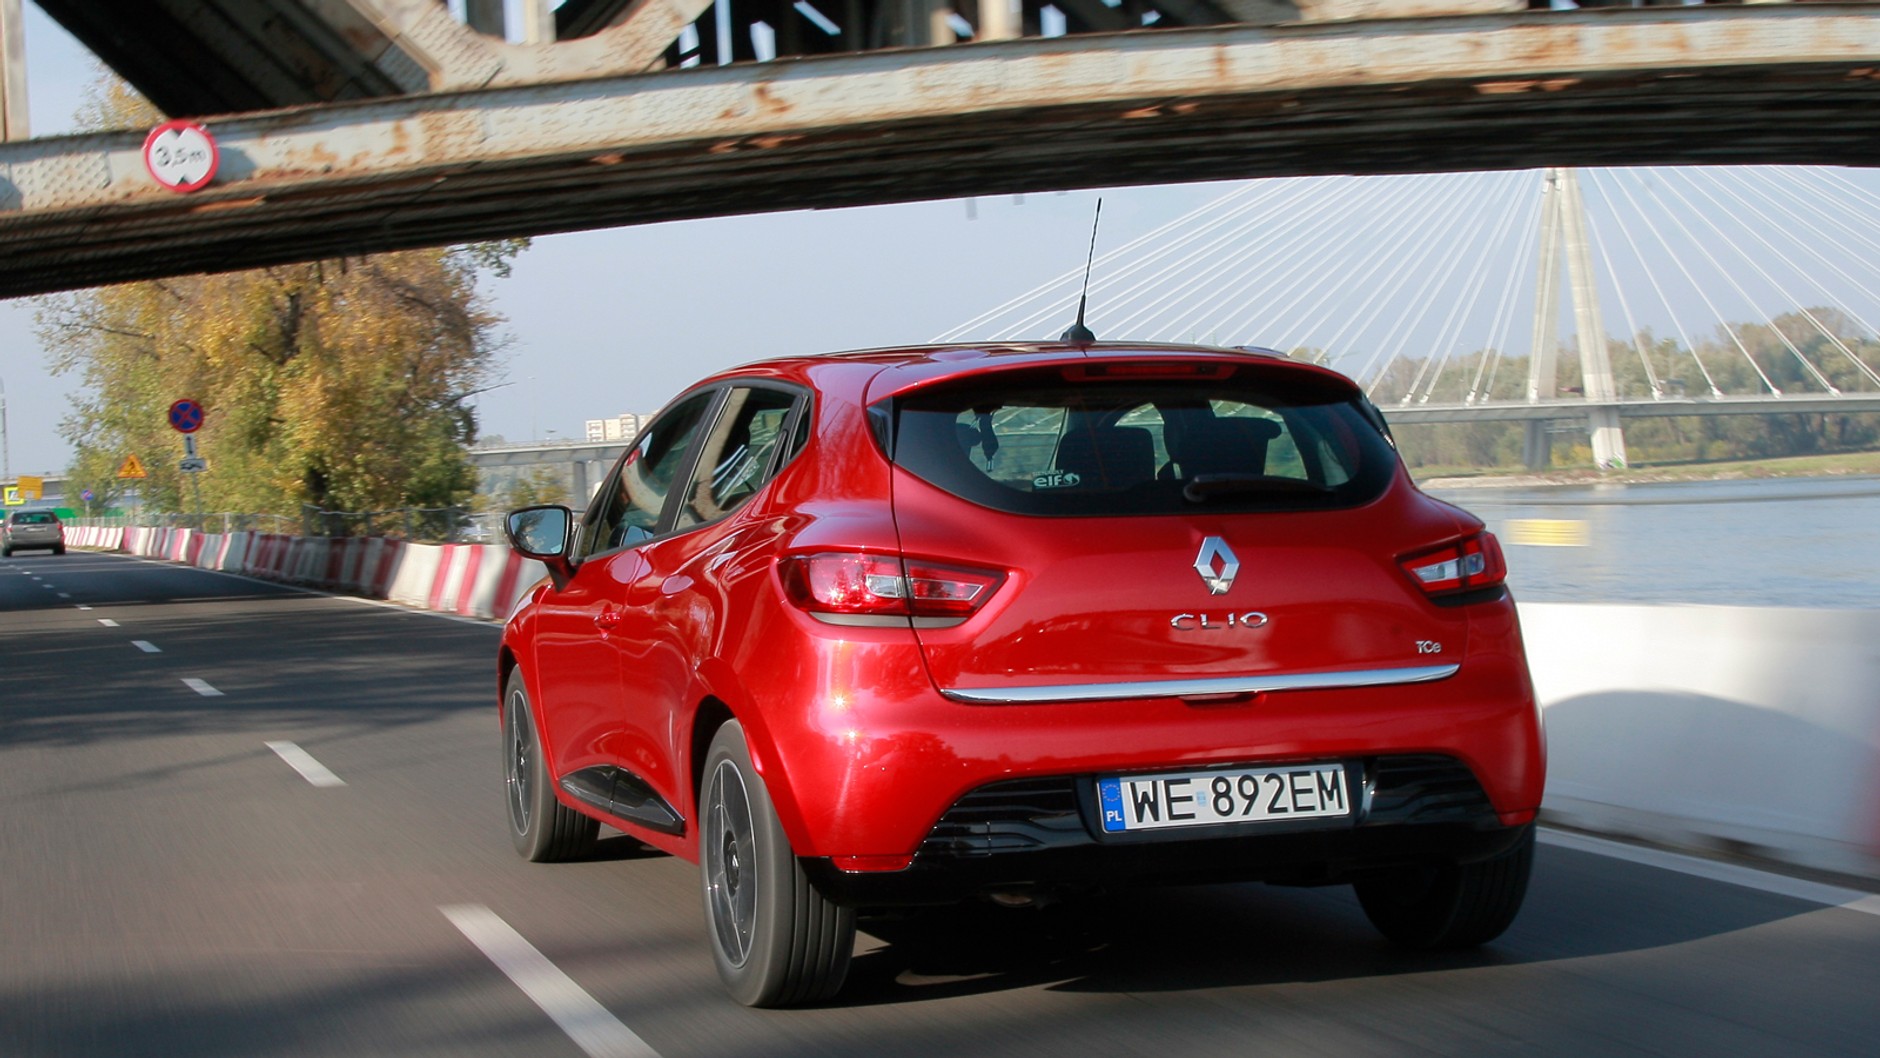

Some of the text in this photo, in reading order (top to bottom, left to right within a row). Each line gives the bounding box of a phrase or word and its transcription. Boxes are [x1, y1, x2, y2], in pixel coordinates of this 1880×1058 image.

[1033, 475, 1062, 487] elf
[1170, 611, 1268, 631] CLIO
[1415, 640, 1441, 653] TCe
[1129, 769, 1344, 823] WE 892EM
[1106, 810, 1122, 822] PL
